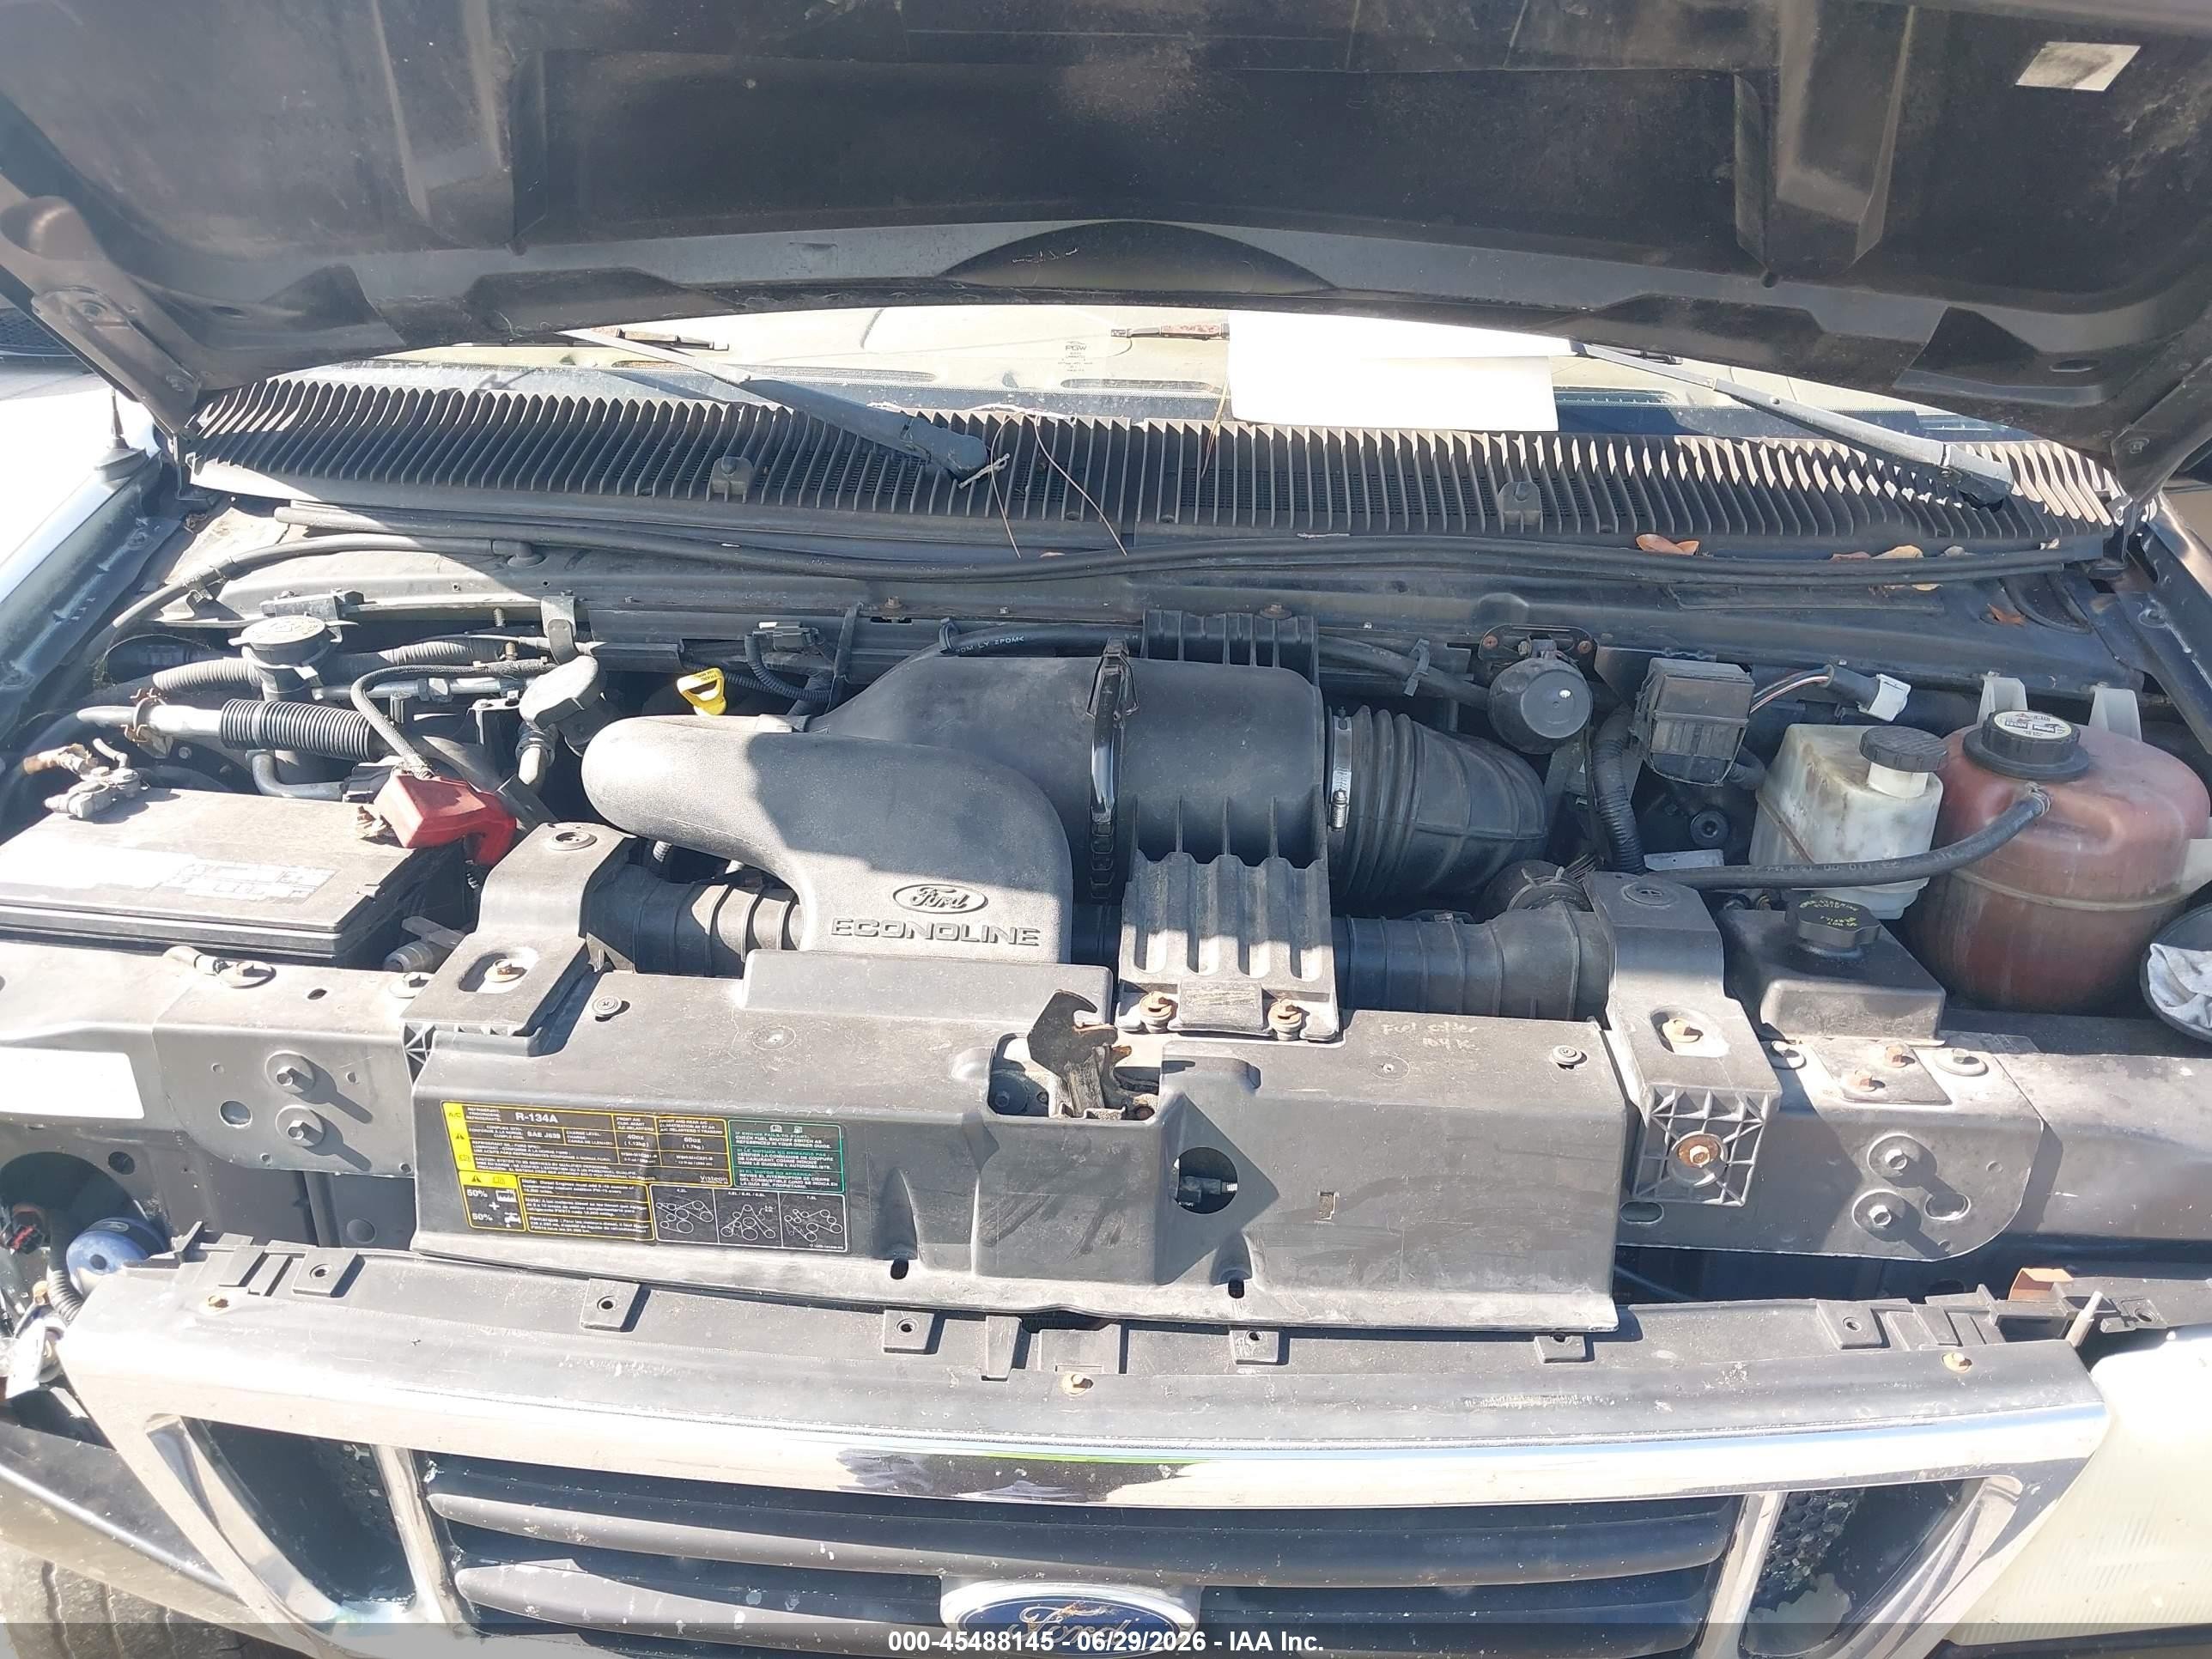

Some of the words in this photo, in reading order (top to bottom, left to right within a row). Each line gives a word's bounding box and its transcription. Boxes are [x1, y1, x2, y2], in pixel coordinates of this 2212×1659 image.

[911, 886, 969, 908] Ford
[831, 917, 1040, 946] ECONOLINE
[515, 1112, 558, 1123] R-134A
[466, 1188, 488, 1197] 50%
[1007, 1601, 1133, 1644] Ford
